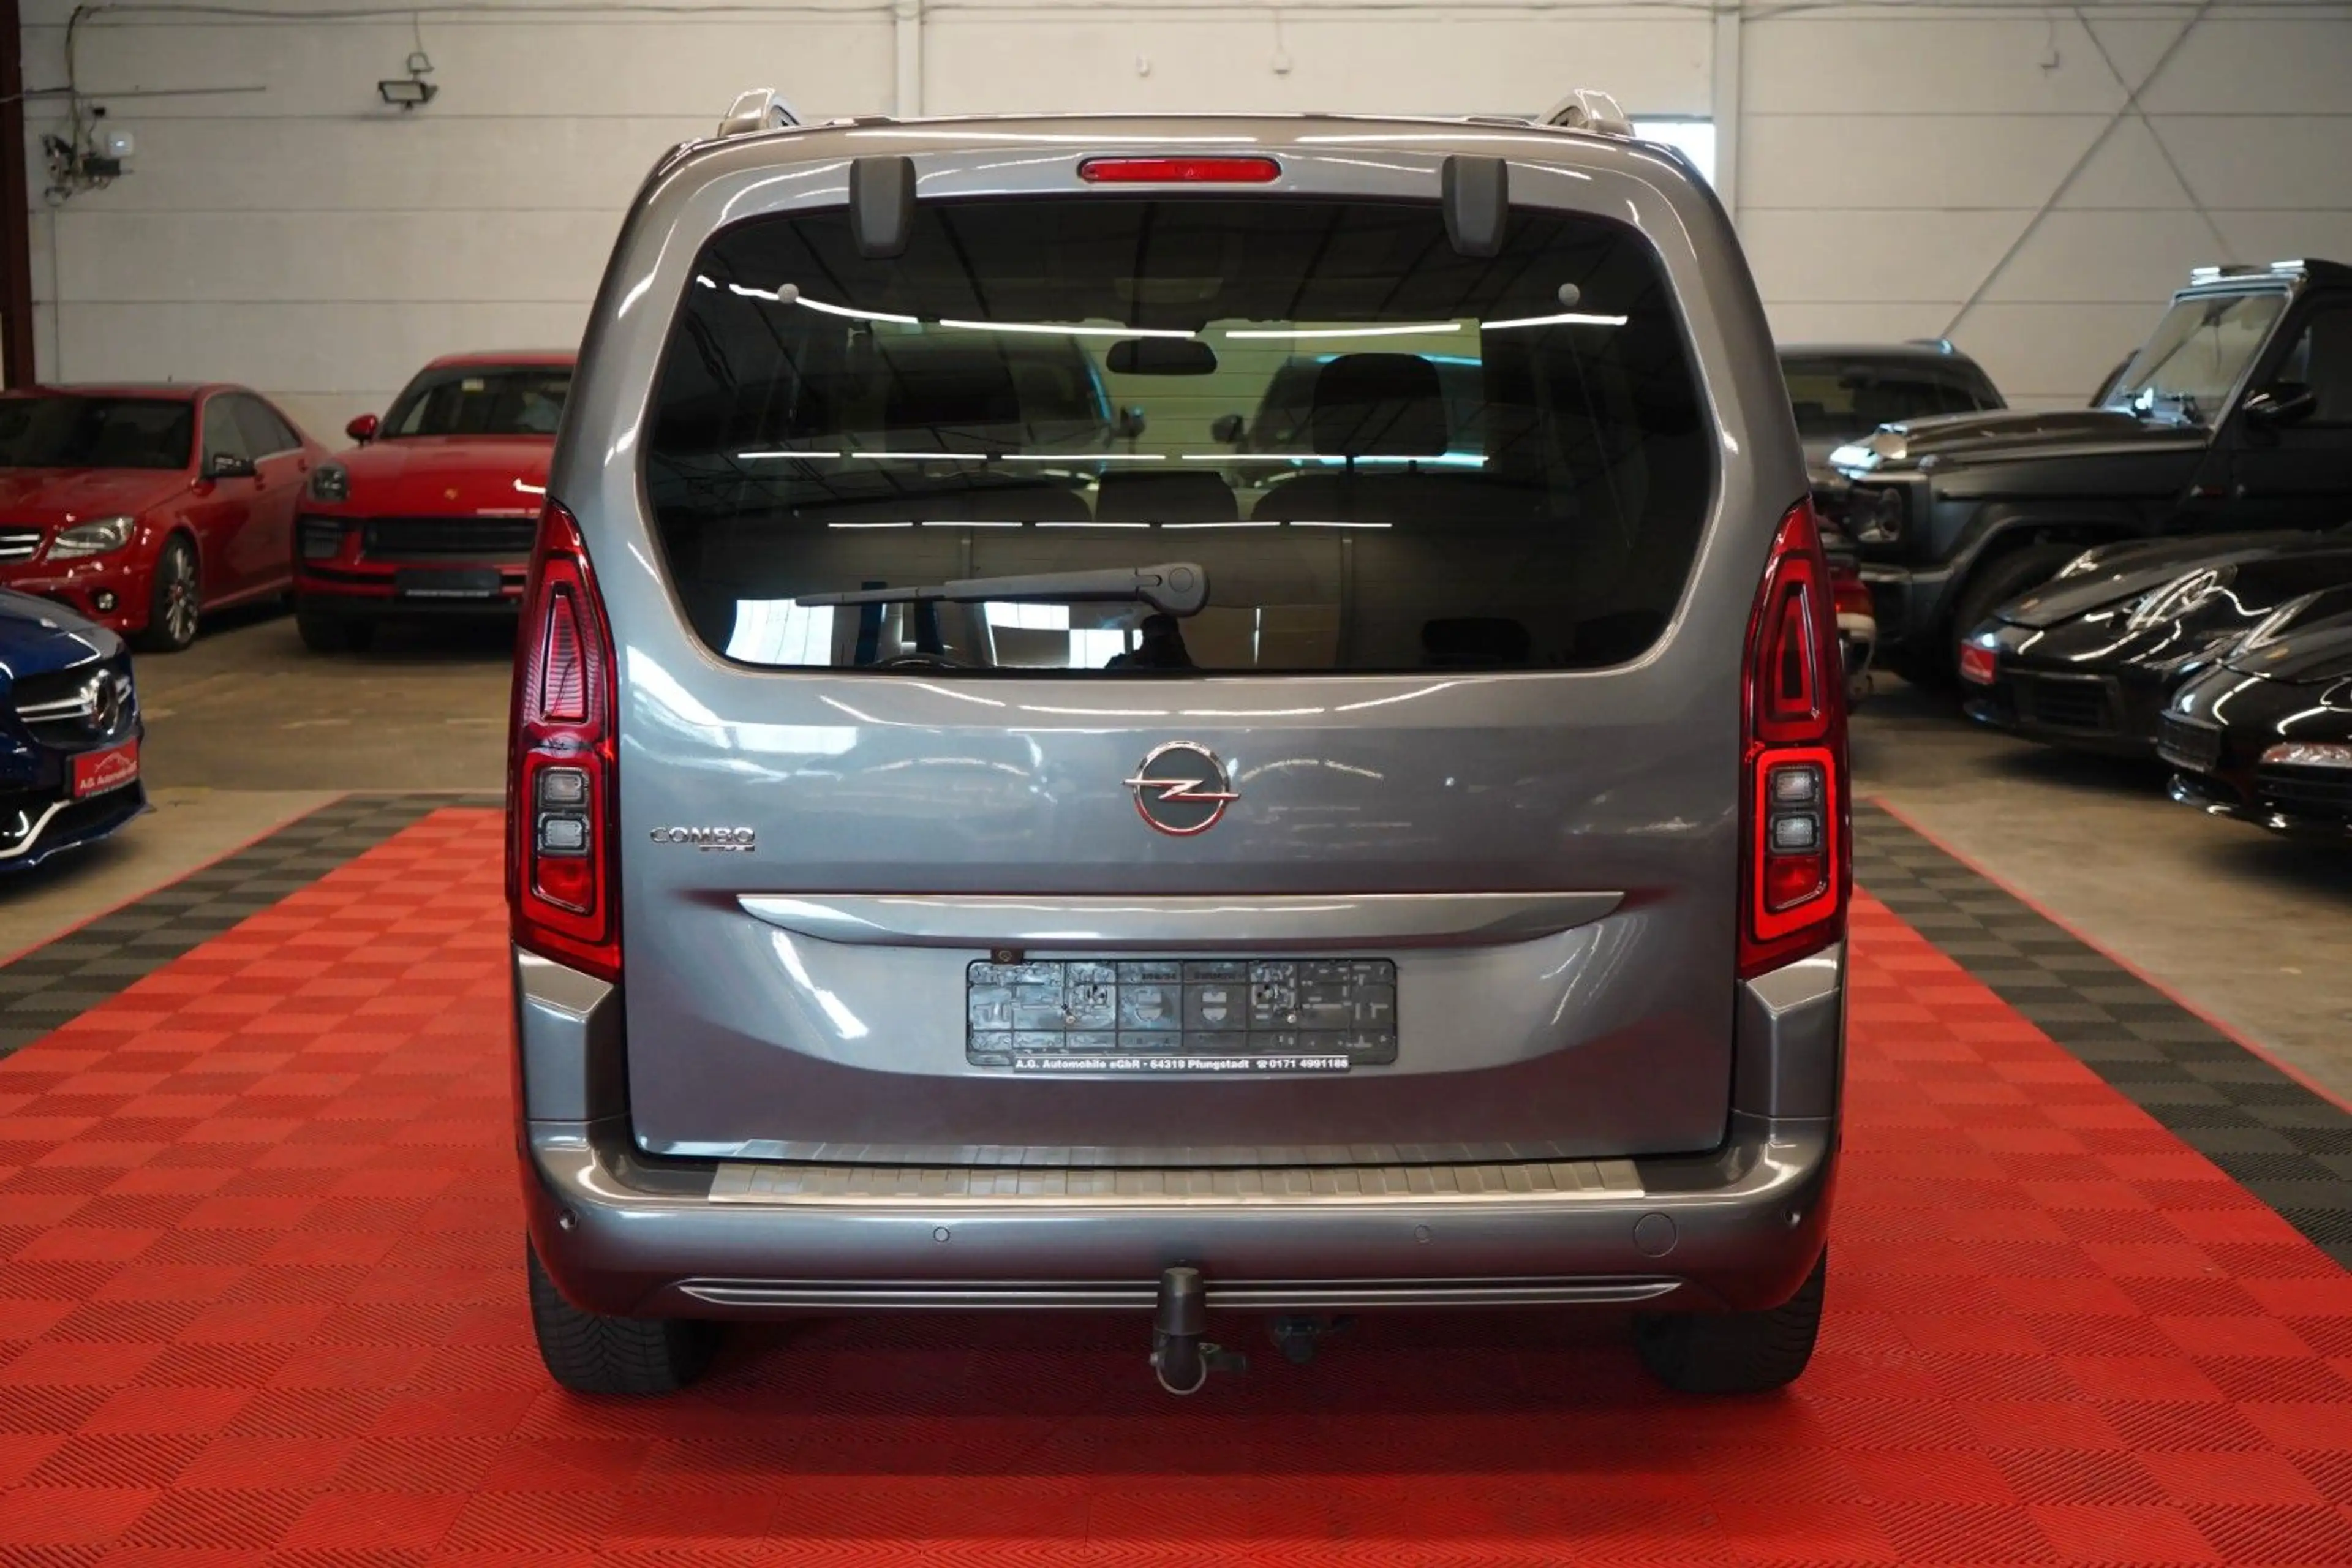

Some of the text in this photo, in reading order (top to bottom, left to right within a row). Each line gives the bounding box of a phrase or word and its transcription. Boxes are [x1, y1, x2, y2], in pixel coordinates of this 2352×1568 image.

[650, 827, 755, 843] COMBO
[1042, 1058, 1106, 1069] Automobile
[1188, 1059, 1250, 1071] Pfungstadt
[1269, 1059, 1296, 1068] 0171
